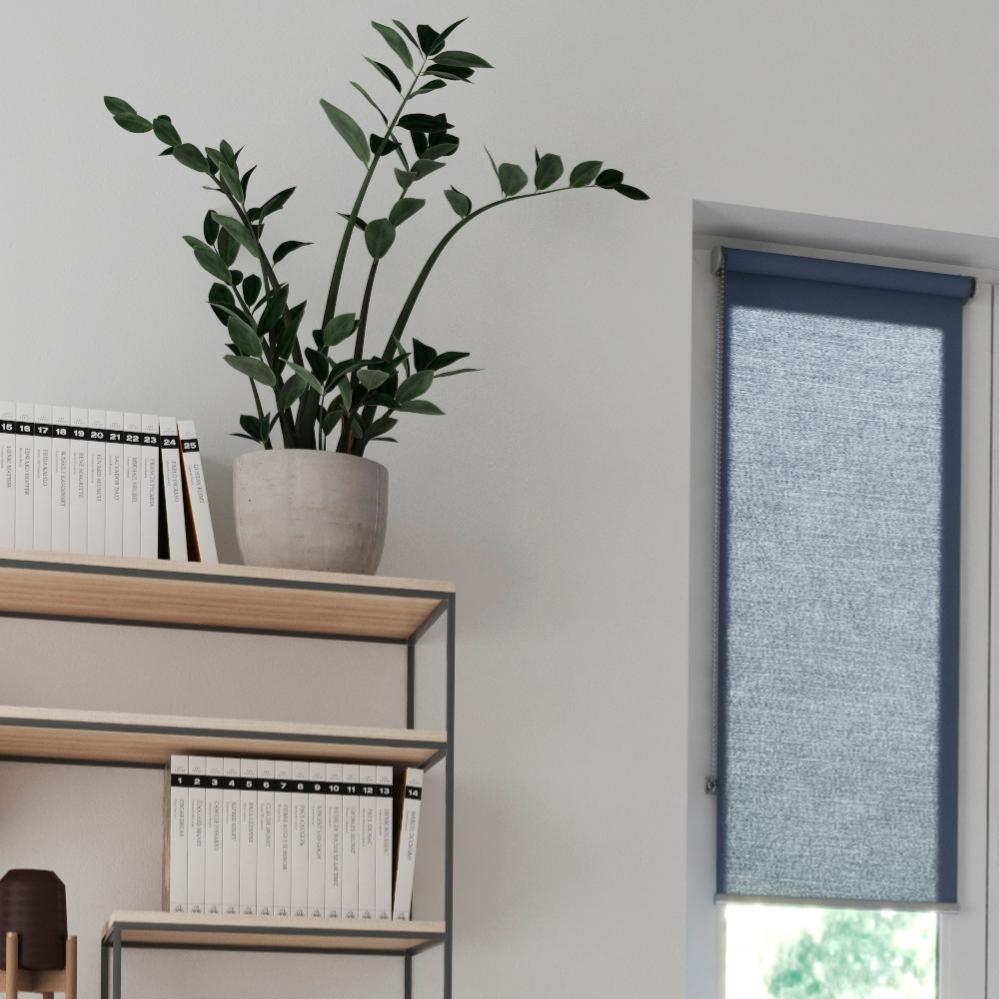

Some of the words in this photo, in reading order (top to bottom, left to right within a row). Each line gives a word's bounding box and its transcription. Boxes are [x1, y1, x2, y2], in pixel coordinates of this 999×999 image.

[1, 423, 13, 431] 15
[38, 426, 49, 434] 17
[91, 431, 104, 439] 20
[144, 436, 157, 444] 23
[184, 441, 196, 449] 25
